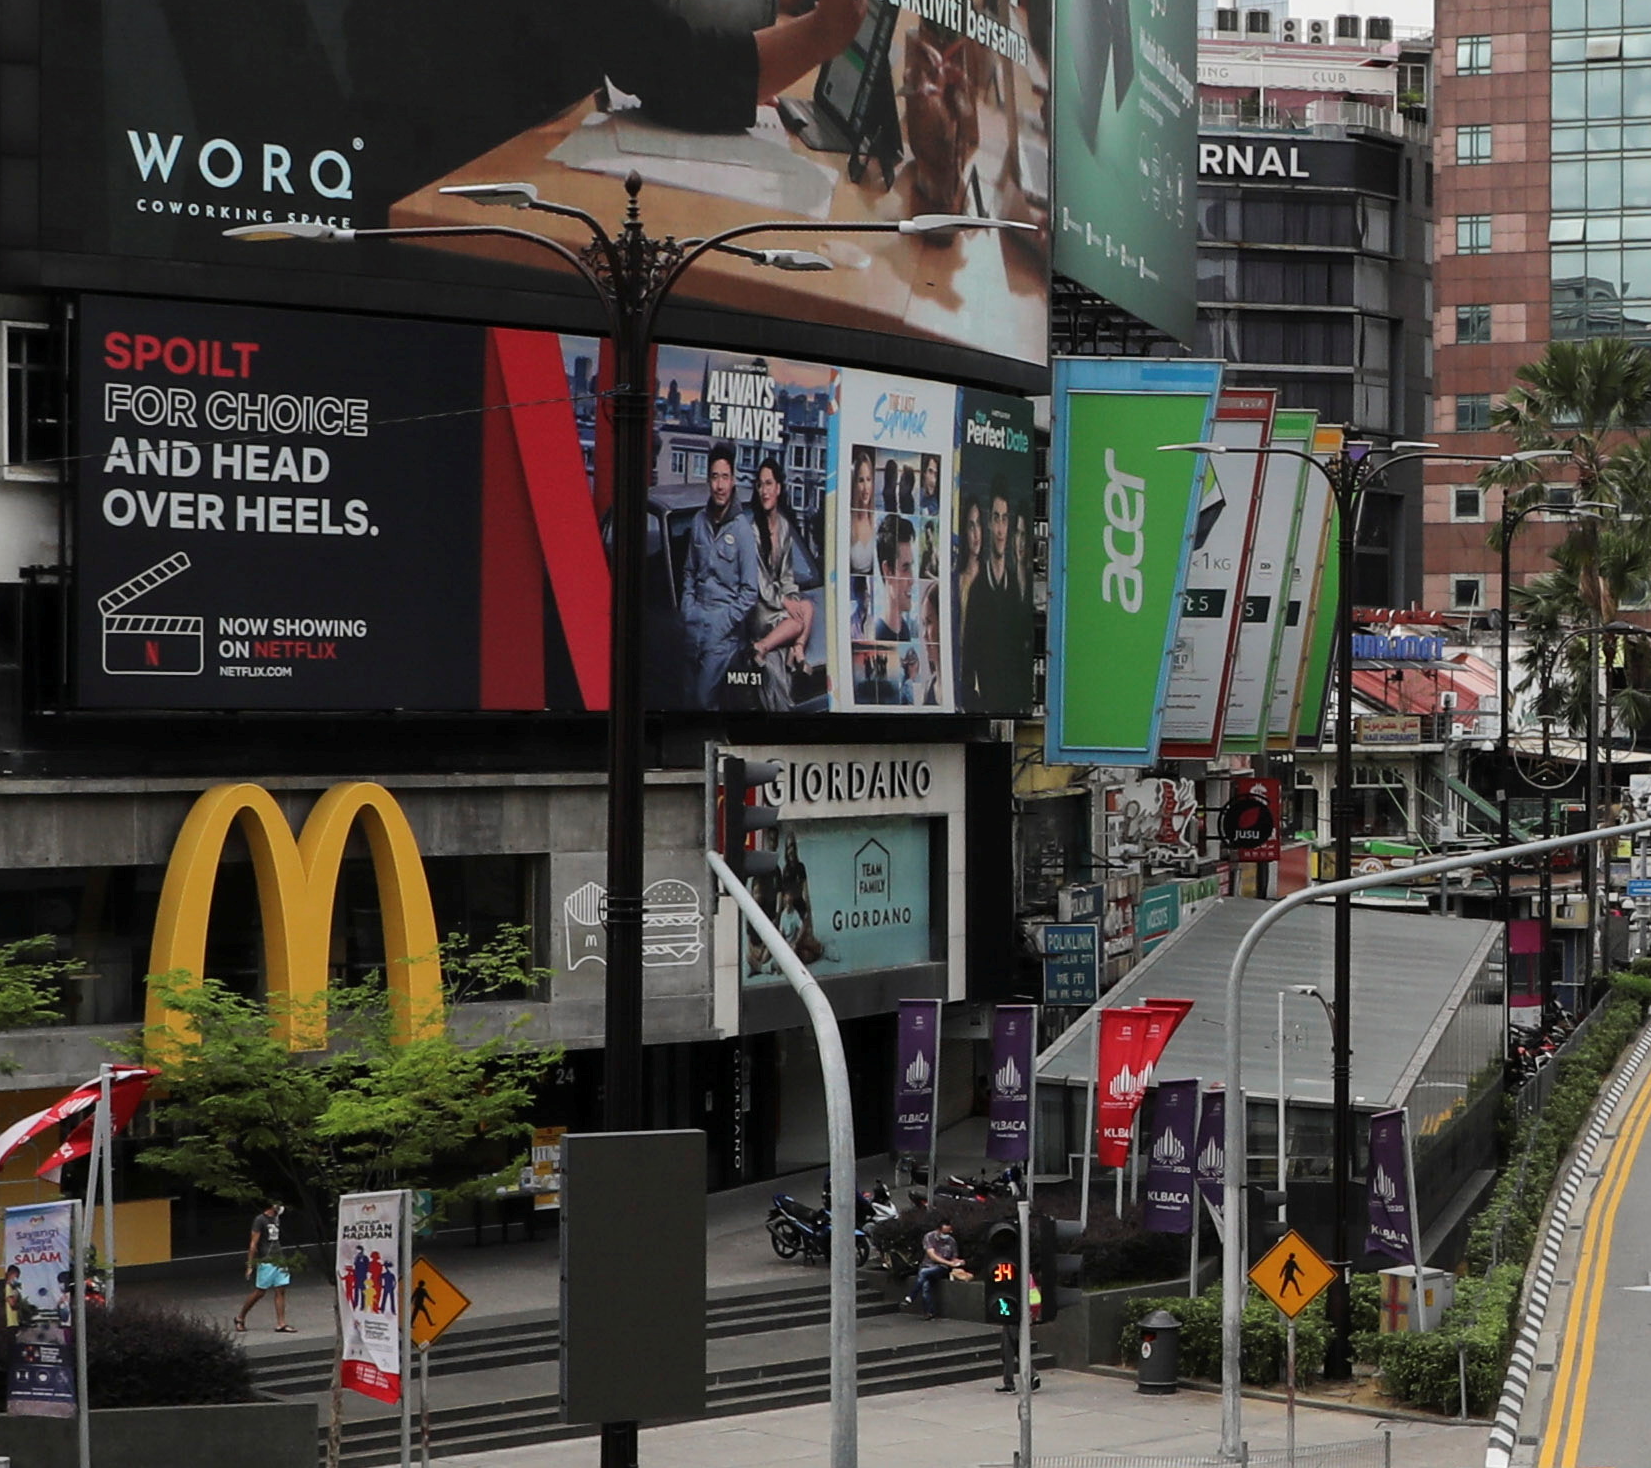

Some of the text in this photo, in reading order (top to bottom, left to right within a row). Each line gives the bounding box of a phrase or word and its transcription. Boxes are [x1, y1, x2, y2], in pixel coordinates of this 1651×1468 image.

[966, 0, 1028, 66] bersama
[1312, 71, 1346, 83] CLUB
[136, 199, 351, 229] COWORKING SPACE
[105, 331, 259, 378] SPOILT
[707, 370, 776, 409] ALWAYS
[104, 384, 369, 437] FOR CHOICE
[709, 404, 721, 421] BE
[725, 405, 785, 444] MAYBE
[967, 419, 1029, 453] Perfect Date
[104, 436, 329, 483] AND HEAD
[102, 489, 380, 536] OVER HEELS.
[1103, 448, 1146, 613] acer
[1213, 558, 1231, 570] KG
[1199, 596, 1209, 611] 5
[219, 617, 367, 638] NOW SHOWING
[219, 640, 337, 660] ON NETFLIX
[219, 665, 293, 678] NETFLIX.COM
[727, 670, 762, 686] MAY 31
[763, 759, 932, 807] GIORDANO
[861, 863, 882, 877] TEAM
[859, 880, 886, 895] FAMILY
[833, 907, 911, 932] GIORDANO
[1147, 1190, 1190, 1204] KLBACA
[14, 1252, 62, 1266] SALAM
[994, 1264, 1012, 1282] 34
